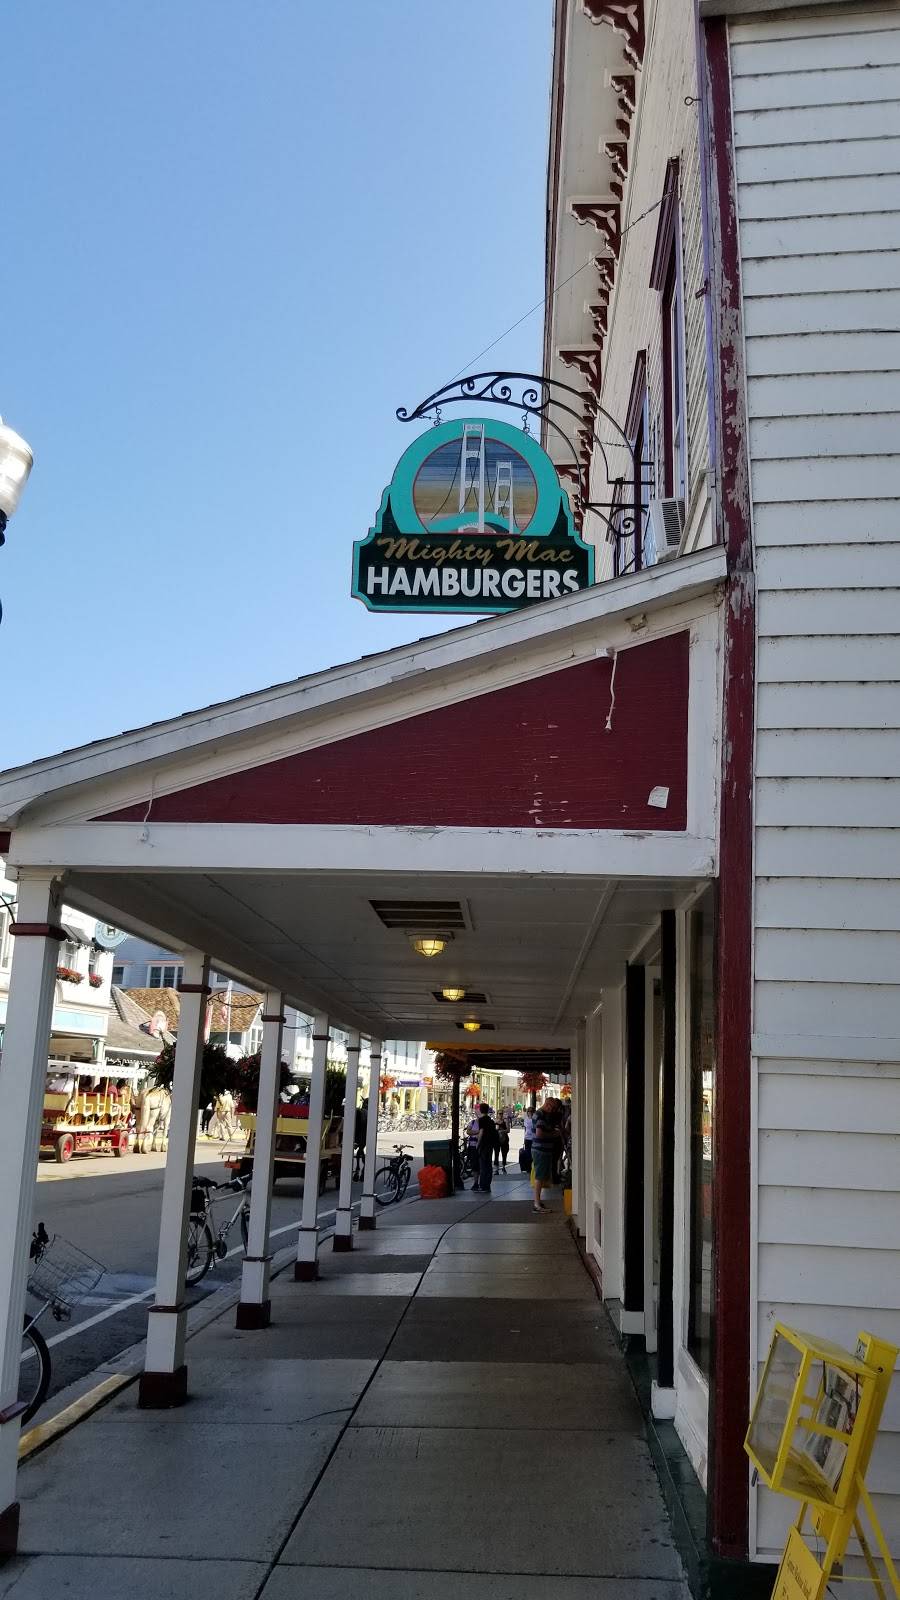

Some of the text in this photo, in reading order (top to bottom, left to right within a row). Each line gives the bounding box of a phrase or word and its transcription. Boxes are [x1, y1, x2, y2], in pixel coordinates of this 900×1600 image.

[377, 537, 574, 566] Mighty Mac
[367, 566, 580, 598] HAMBURGERS
